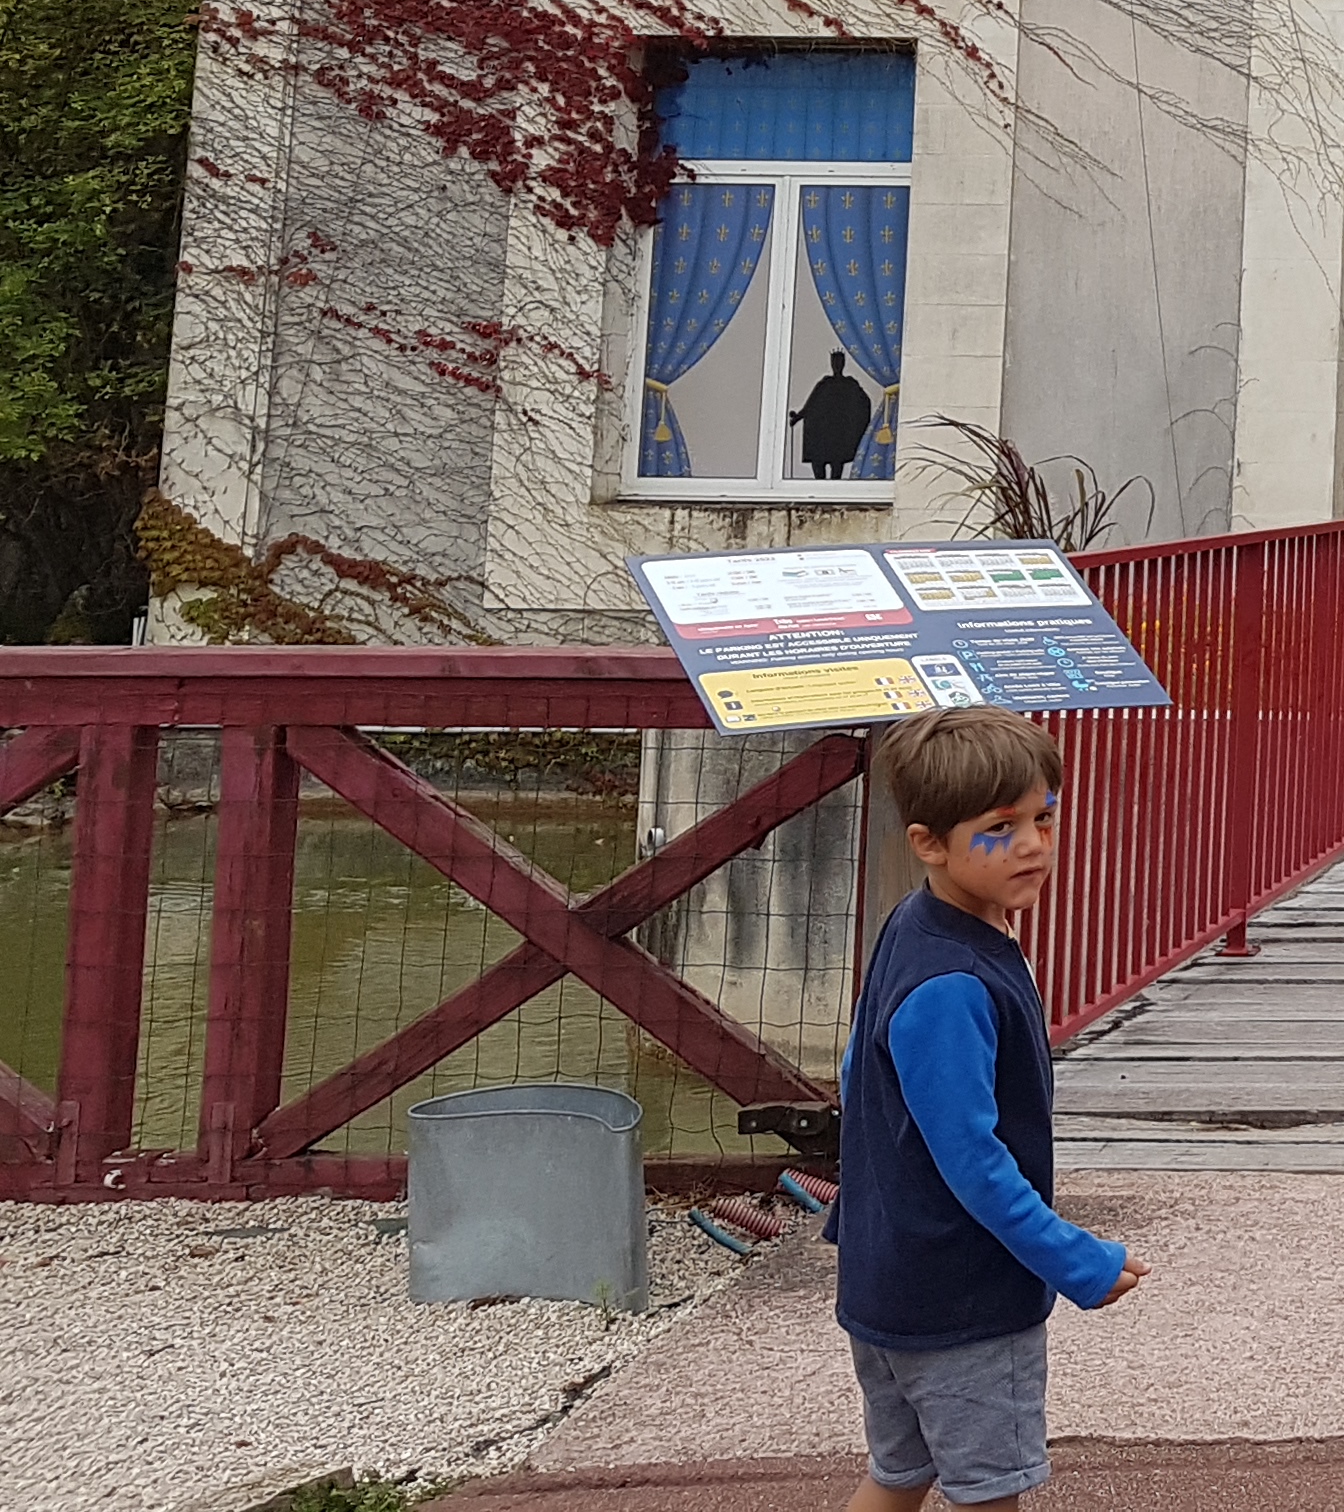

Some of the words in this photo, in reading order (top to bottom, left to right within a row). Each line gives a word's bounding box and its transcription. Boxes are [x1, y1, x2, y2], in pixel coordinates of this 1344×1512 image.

[956, 618, 1035, 629] Informations
[1036, 617, 1093, 627] pratiques
[715, 643, 763, 653] PARKING
[765, 641, 785, 649] EST
[853, 632, 918, 643] UNIQUEMENT
[717, 651, 760, 661] DURANT
[752, 668, 821, 679] Informations
